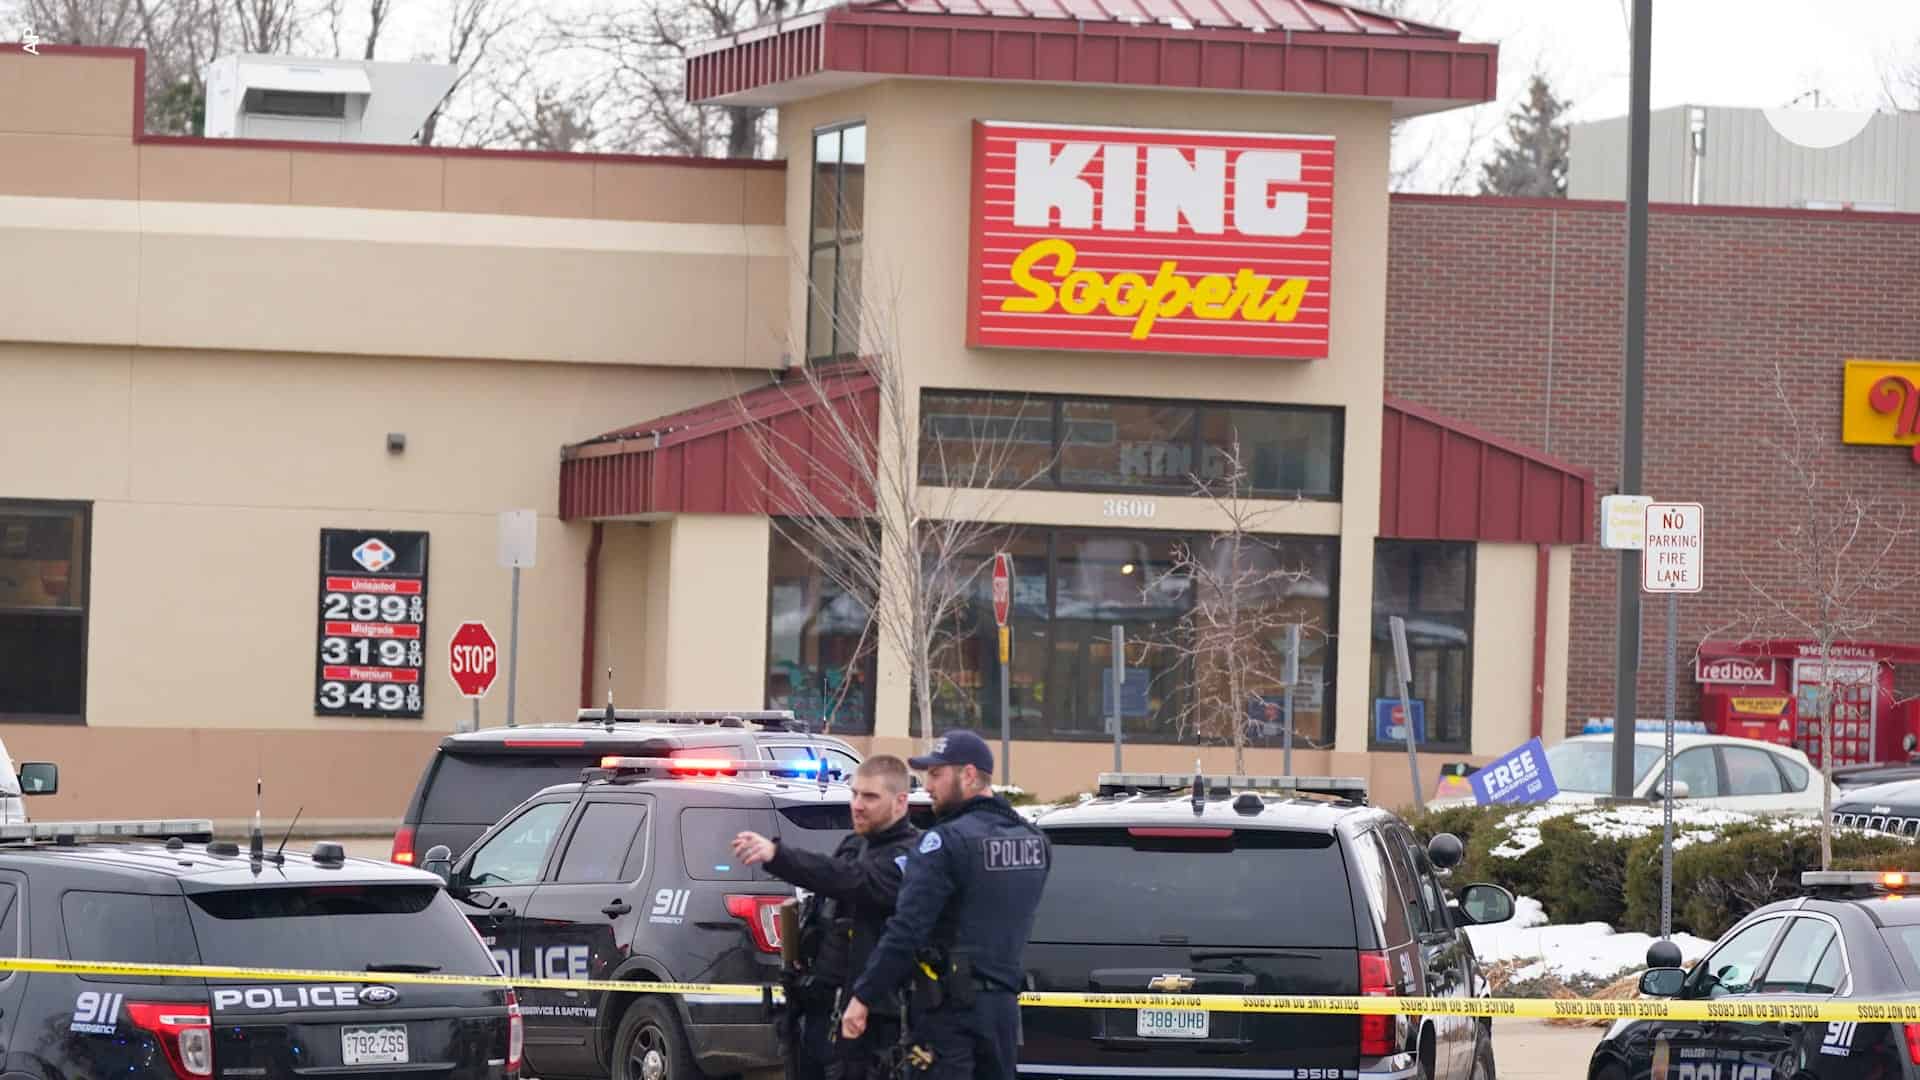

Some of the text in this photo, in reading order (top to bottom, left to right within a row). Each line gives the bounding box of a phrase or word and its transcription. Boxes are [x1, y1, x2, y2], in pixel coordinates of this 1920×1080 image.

[1013, 141, 1309, 237] KING
[1001, 238, 1310, 340] Soopers
[1103, 499, 1156, 519] 3600
[1663, 512, 1684, 529] NO
[1649, 535, 1697, 548] PARKING
[1659, 552, 1687, 565] FIRE
[1657, 570, 1688, 582] LANE
[351, 580, 396, 593] Unleaded
[324, 592, 407, 622] 289
[351, 622, 394, 636] Midgrade
[321, 637, 406, 666] 319
[452, 645, 495, 674] STOP
[350, 667, 392, 680] Premium
[1703, 663, 1764, 680] redbox
[319, 681, 405, 710] 349
[1482, 750, 1536, 794] FREE
[990, 839, 1041, 867] POLICE
[652, 889, 690, 915] 911
[491, 945, 590, 980] OLICE
[214, 985, 360, 1011] POLICE
[1308, 999, 1327, 1009] LINE
[1329, 999, 1359, 1010] POLICE
[1401, 999, 1515, 1014] POLICE LINE DO NOT CROSS
[73, 991, 124, 1025] 911
[1554, 1001, 1668, 1017] POLICE LINE DO NOT CROSS
[1707, 1003, 1819, 1018] POLICE LINE DO NOT CROSS
[1857, 1005, 1916, 1019] DO NOT CROSS
[1823, 1022, 1857, 1046] 911
[1297, 1068, 1340, 1080] 3518
